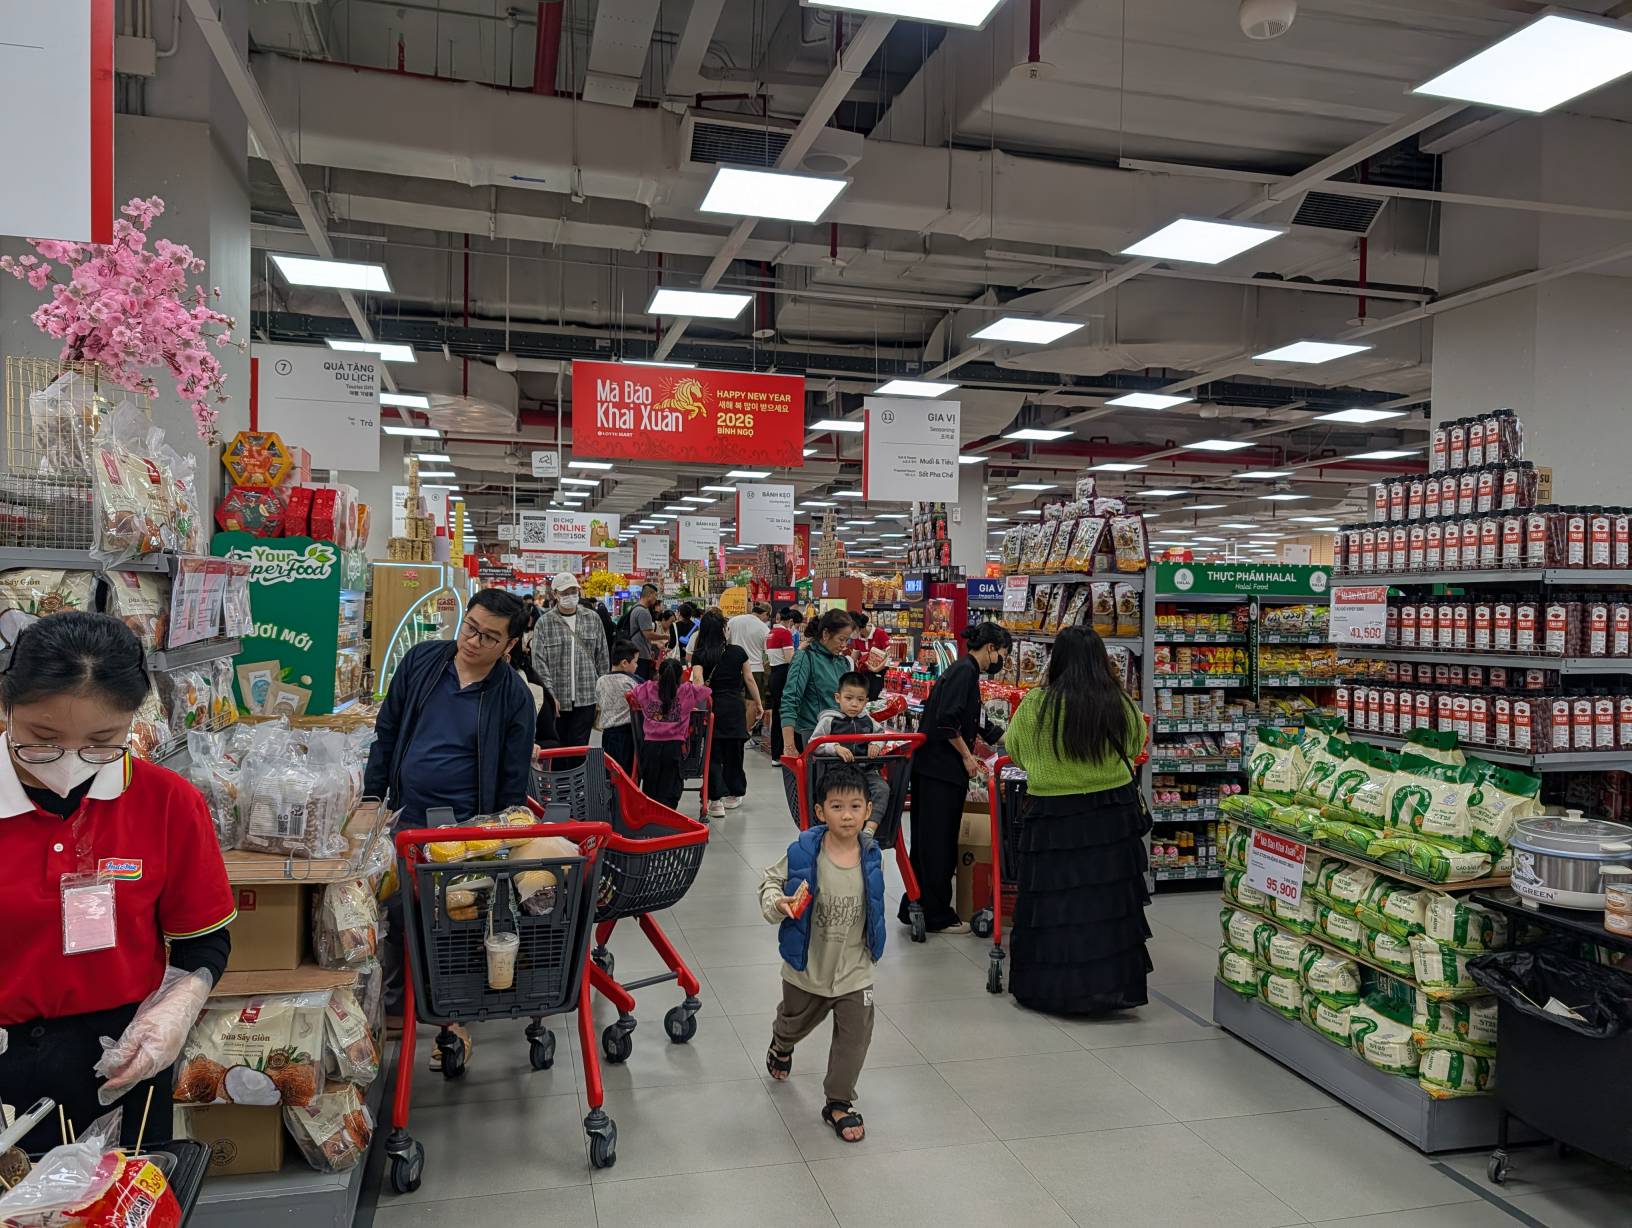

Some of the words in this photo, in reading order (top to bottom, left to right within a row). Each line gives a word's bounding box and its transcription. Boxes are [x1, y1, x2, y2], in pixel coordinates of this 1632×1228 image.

[323, 361, 345, 371] QUÀ
[347, 362, 375, 373] TẶNG
[336, 372, 349, 381] DU
[351, 373, 374, 383] LỊCH
[597, 378, 620, 402] Mã
[716, 390, 747, 399] HAPPY
[747, 392, 767, 401] NEW
[768, 393, 792, 402] YEAR
[718, 401, 734, 409] 새해
[735, 401, 742, 410] 복
[743, 402, 759, 411] 많이
[759, 403, 790, 413] 받으세요
[360, 418, 374, 427] Trà
[597, 402, 634, 429] Khai
[640, 404, 683, 432] Xuân
[716, 412, 754, 428] 2026
[927, 413, 944, 422] GIA
[946, 414, 956, 424] VỊ
[737, 428, 754, 438] NGỌ
[552, 523, 587, 532] ONLINE
[255, 549, 294, 563] Your
[1207, 571, 1235, 583] THỰC
[1236, 570, 1264, 582] PHẨM
[1267, 572, 1296, 582] HALAL
[979, 584, 995, 592] GIA
[997, 584, 1004, 592] V
[243, 621, 276, 639] ƯƠI
[280, 628, 313, 651] MỚI
[1350, 627, 1381, 640] 41,500
[106, 861, 137, 870] Indomie
[1266, 877, 1297, 899] 95,900
[1523, 886, 1554, 900] GREEN
[221, 1032, 236, 1041] Dừa
[236, 1032, 251, 1043] Sấy
[251, 1033, 270, 1042] Giòn
